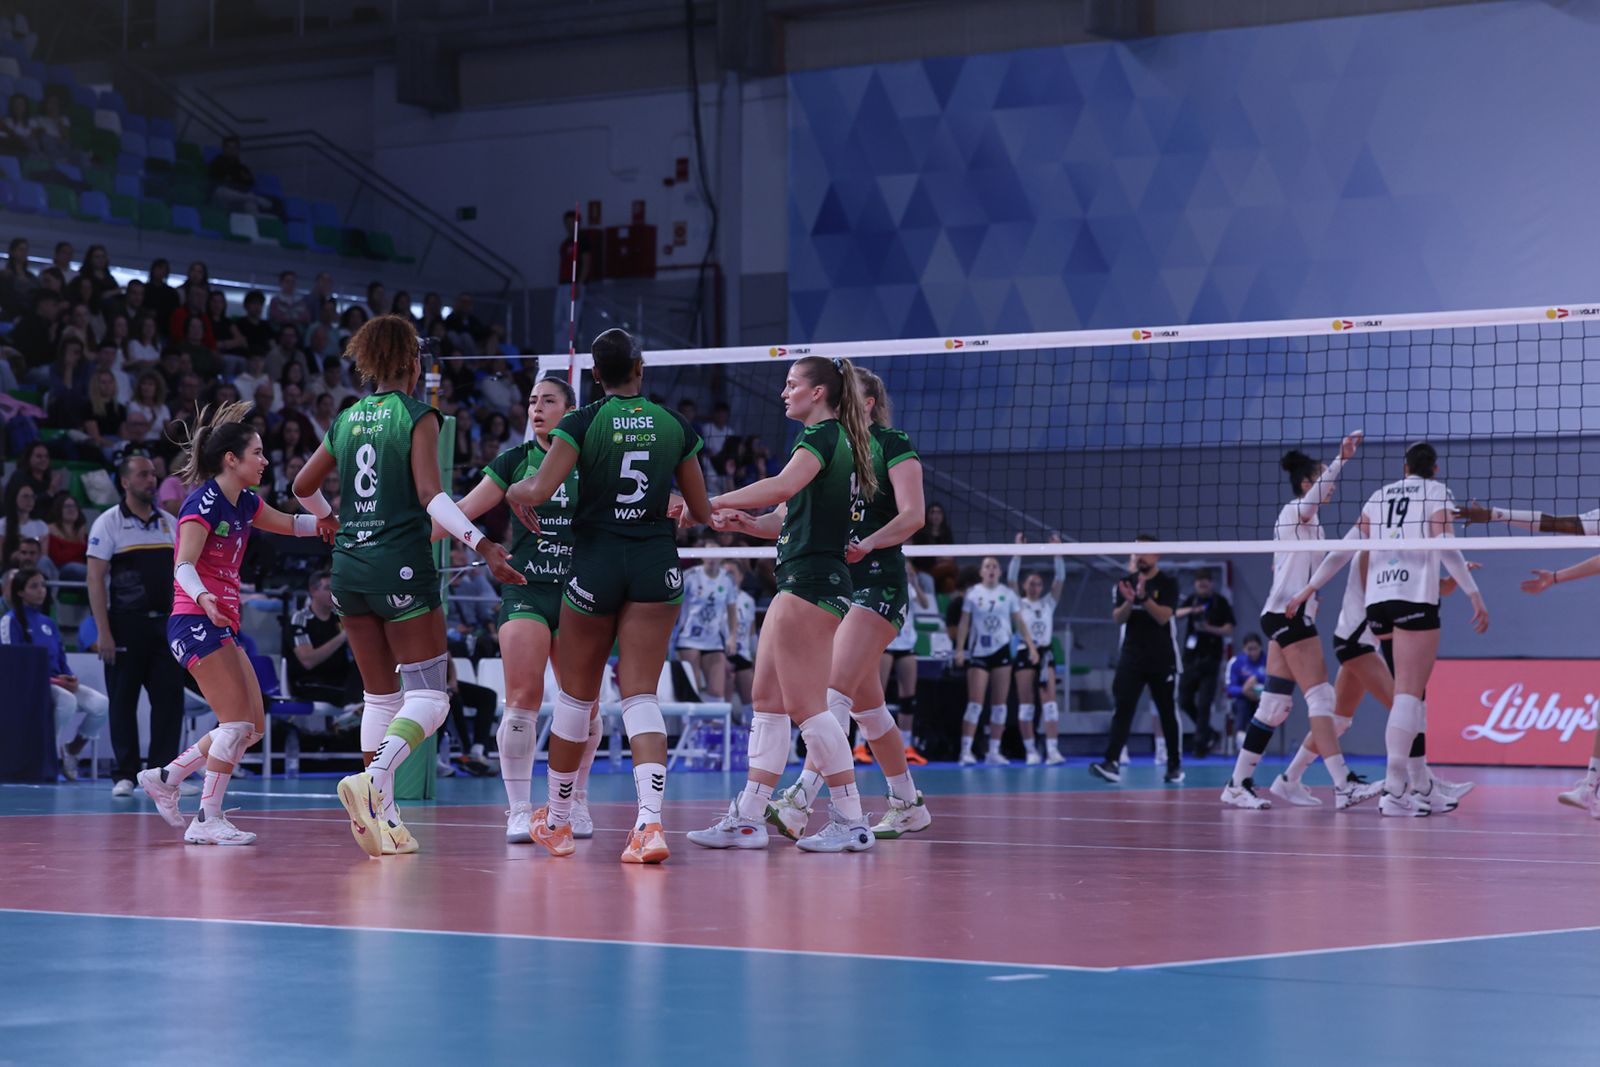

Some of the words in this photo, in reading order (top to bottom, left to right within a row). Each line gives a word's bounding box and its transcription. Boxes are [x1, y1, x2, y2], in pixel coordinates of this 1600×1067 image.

[613, 416, 654, 430] BURSE
[625, 434, 657, 443] ERGOS
[354, 443, 378, 498] 8
[616, 450, 650, 504] 5
[550, 482, 570, 508] 4
[354, 500, 378, 513] WAY
[614, 508, 647, 520] WAY
[1387, 497, 1410, 528] 19
[1377, 569, 1409, 585] LIVVO
